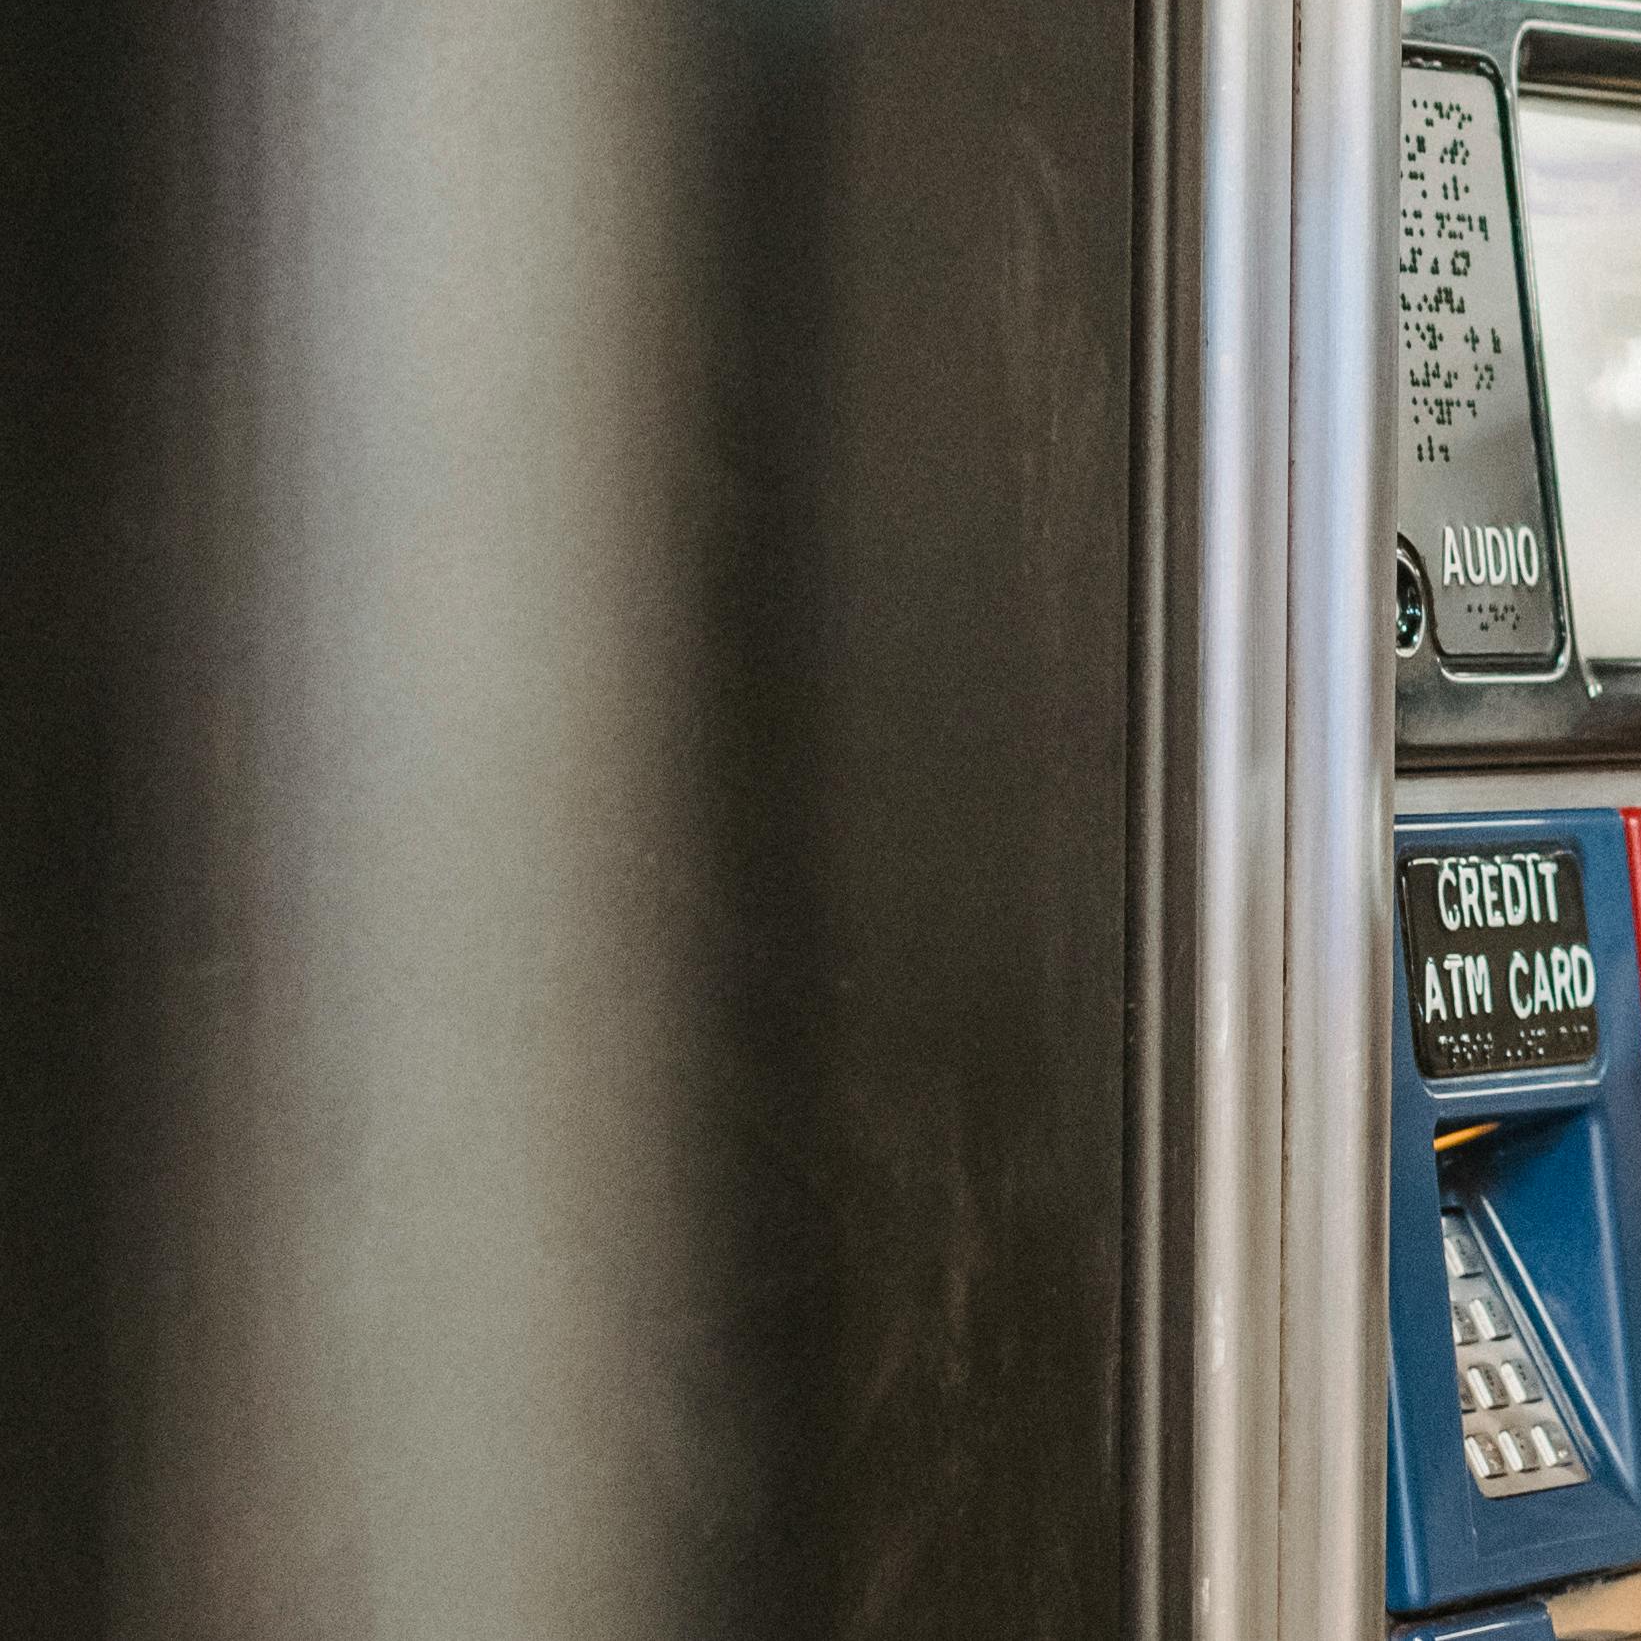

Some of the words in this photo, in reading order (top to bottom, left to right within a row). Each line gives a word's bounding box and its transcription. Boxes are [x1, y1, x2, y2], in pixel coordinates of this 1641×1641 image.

[1443, 525, 1539, 587] AUDIO
[1438, 856, 1558, 931] CREDIT
[1425, 955, 1492, 1024] ATM
[1509, 945, 1596, 1020] CARD
